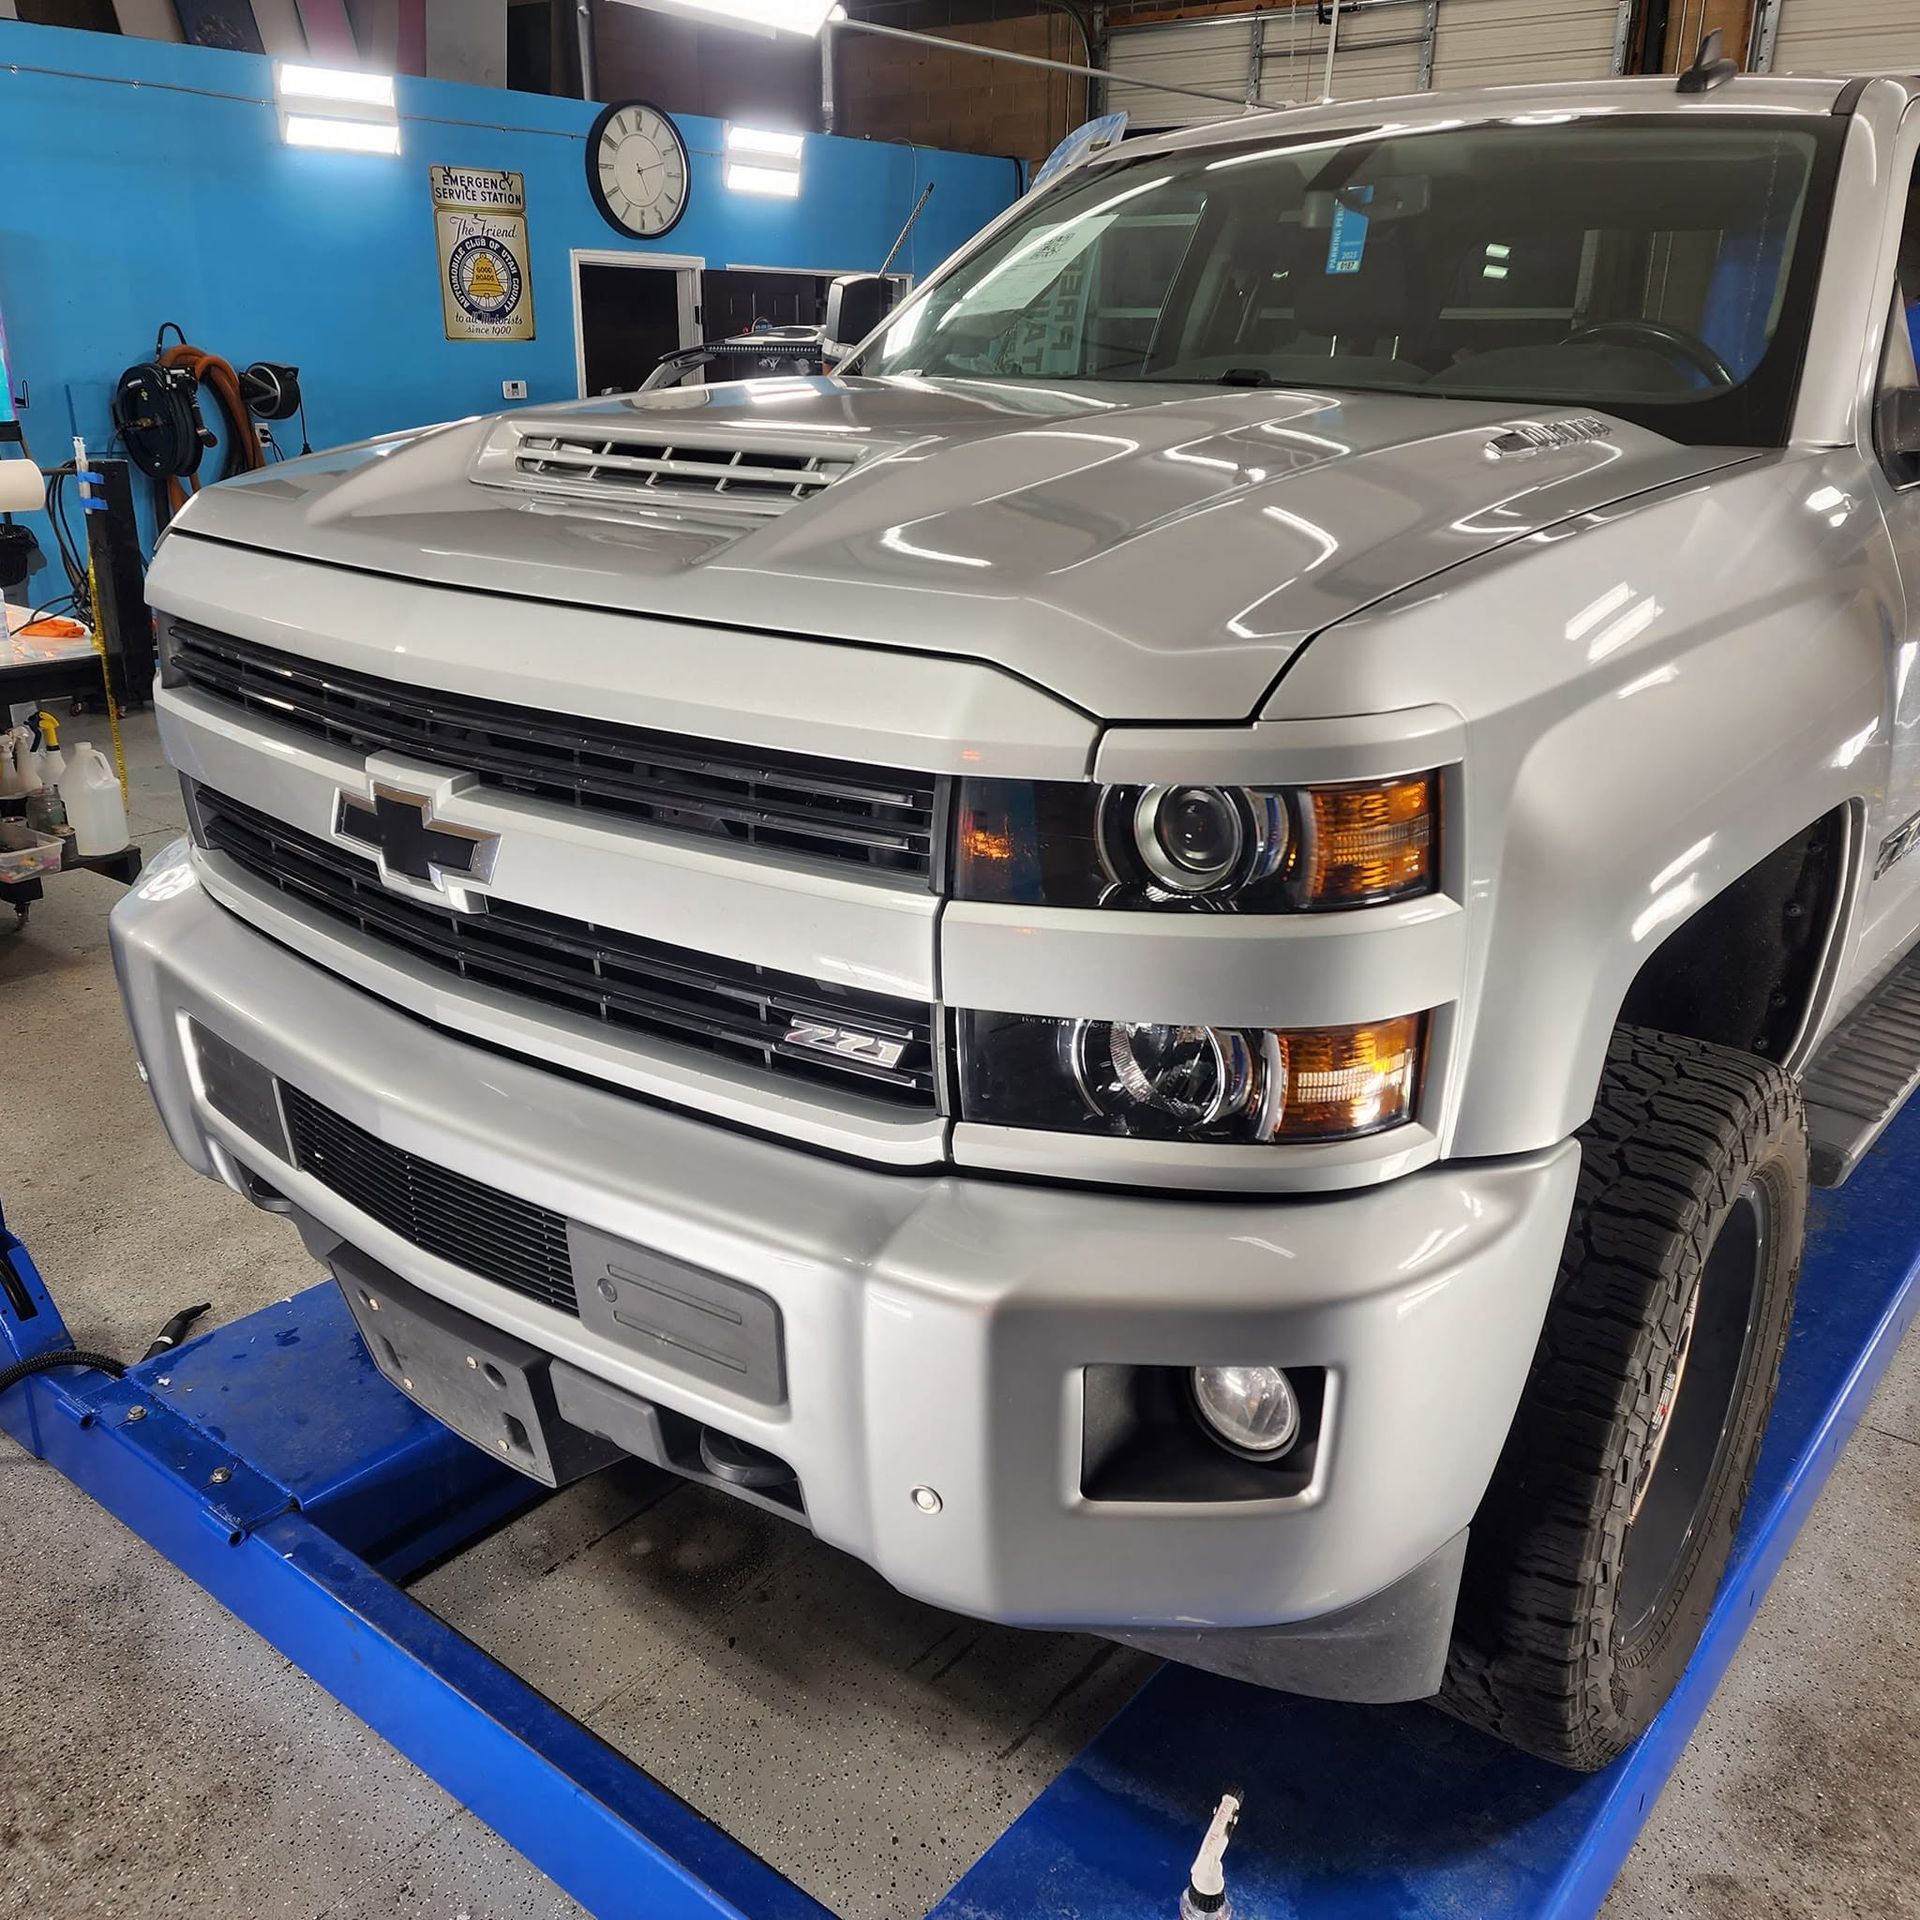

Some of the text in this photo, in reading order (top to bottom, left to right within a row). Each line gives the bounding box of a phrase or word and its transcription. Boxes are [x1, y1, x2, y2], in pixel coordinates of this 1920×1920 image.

[442, 174, 514, 191] EMERGENCY
[435, 187, 522, 206] SERVICE STATION
[450, 216, 517, 246] The Friend
[1329, 230, 1342, 269] PARKING
[451, 238, 519, 313] AUTOMOBILE CLUB OF UTAH COUNTY
[475, 273, 495, 282] ROADS
[455, 312, 464, 323] to
[465, 311, 478, 324] all
[465, 325, 512, 336] since 1900
[783, 1019, 905, 1069] Z71
